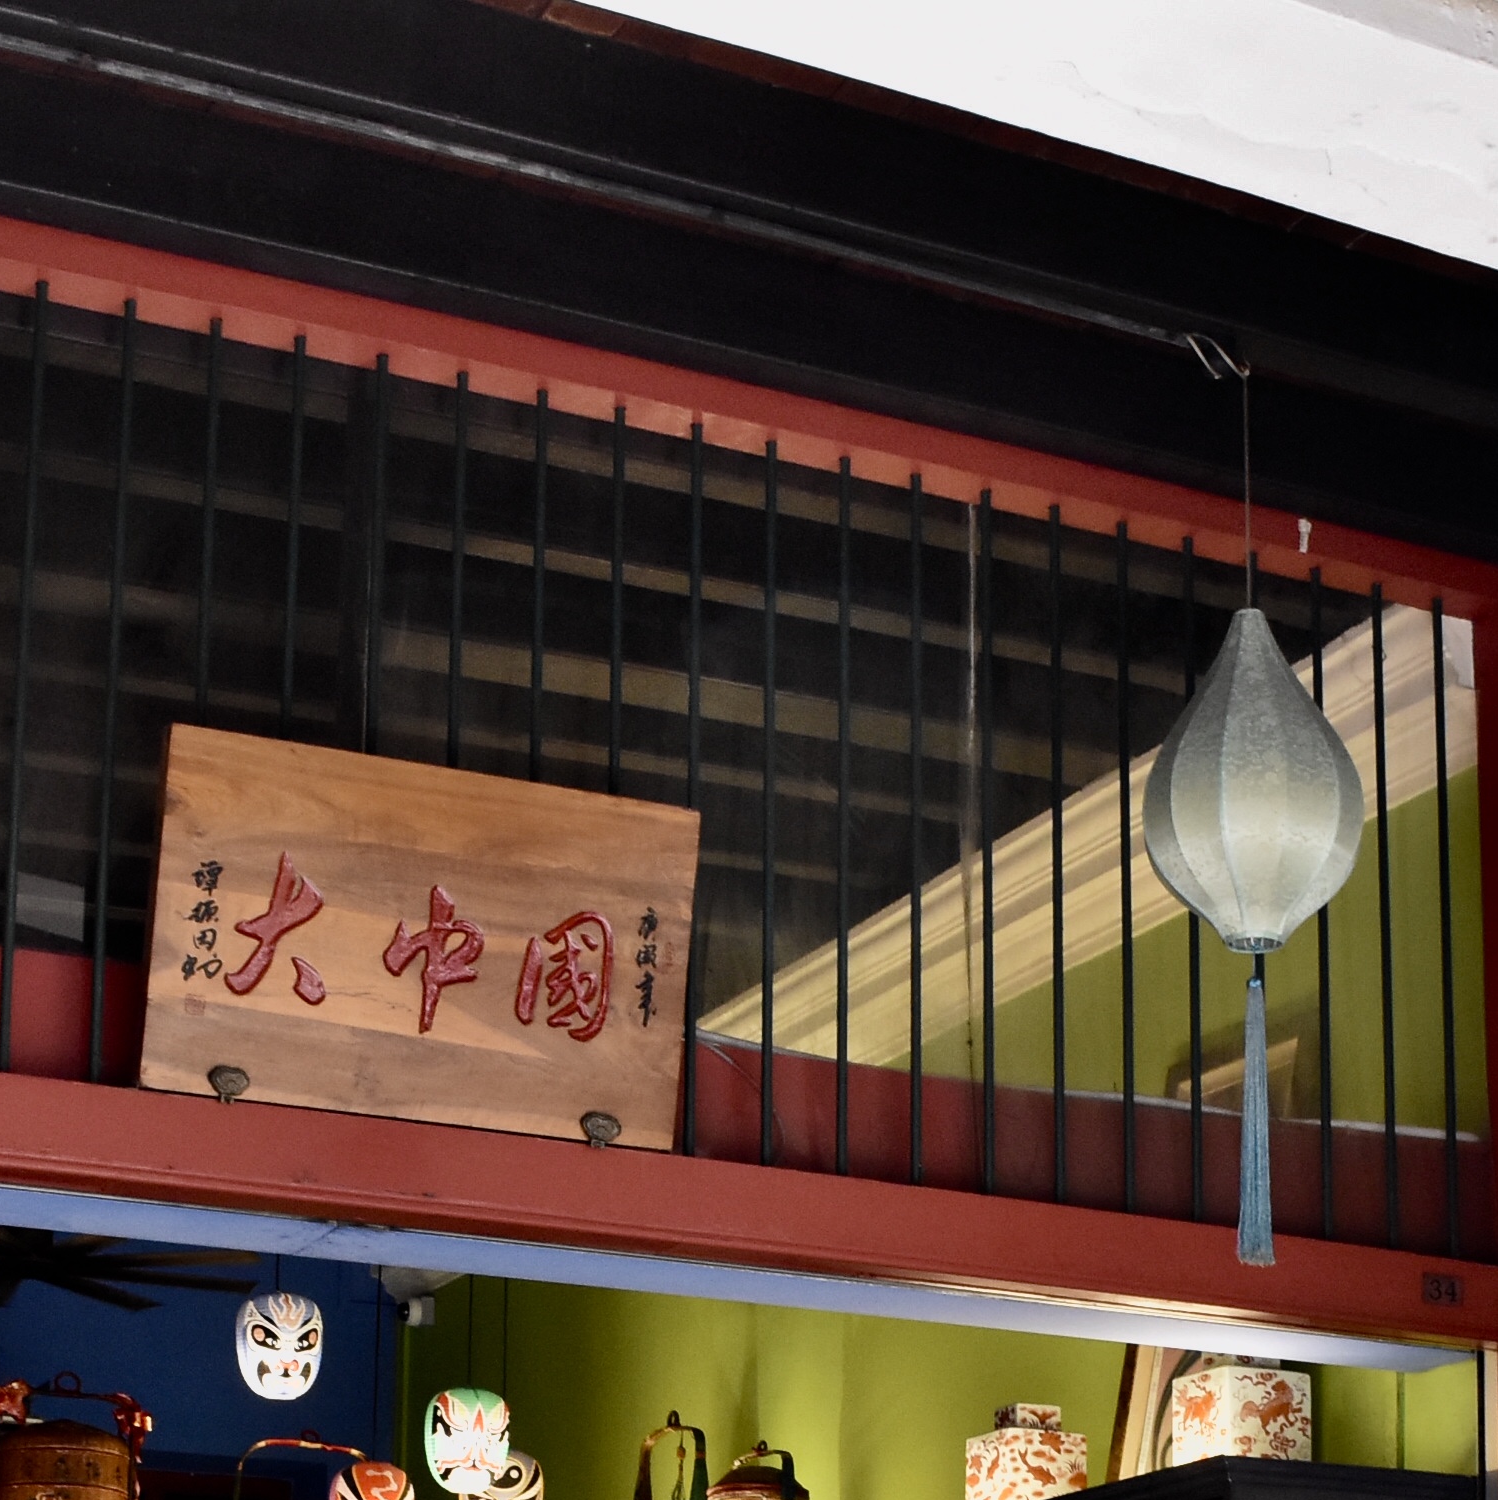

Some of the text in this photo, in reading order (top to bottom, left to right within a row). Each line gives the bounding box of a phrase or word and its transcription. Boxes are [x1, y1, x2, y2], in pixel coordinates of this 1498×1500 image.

[225, 851, 615, 1042] 大中國
[1429, 1279, 1458, 1303] 34
